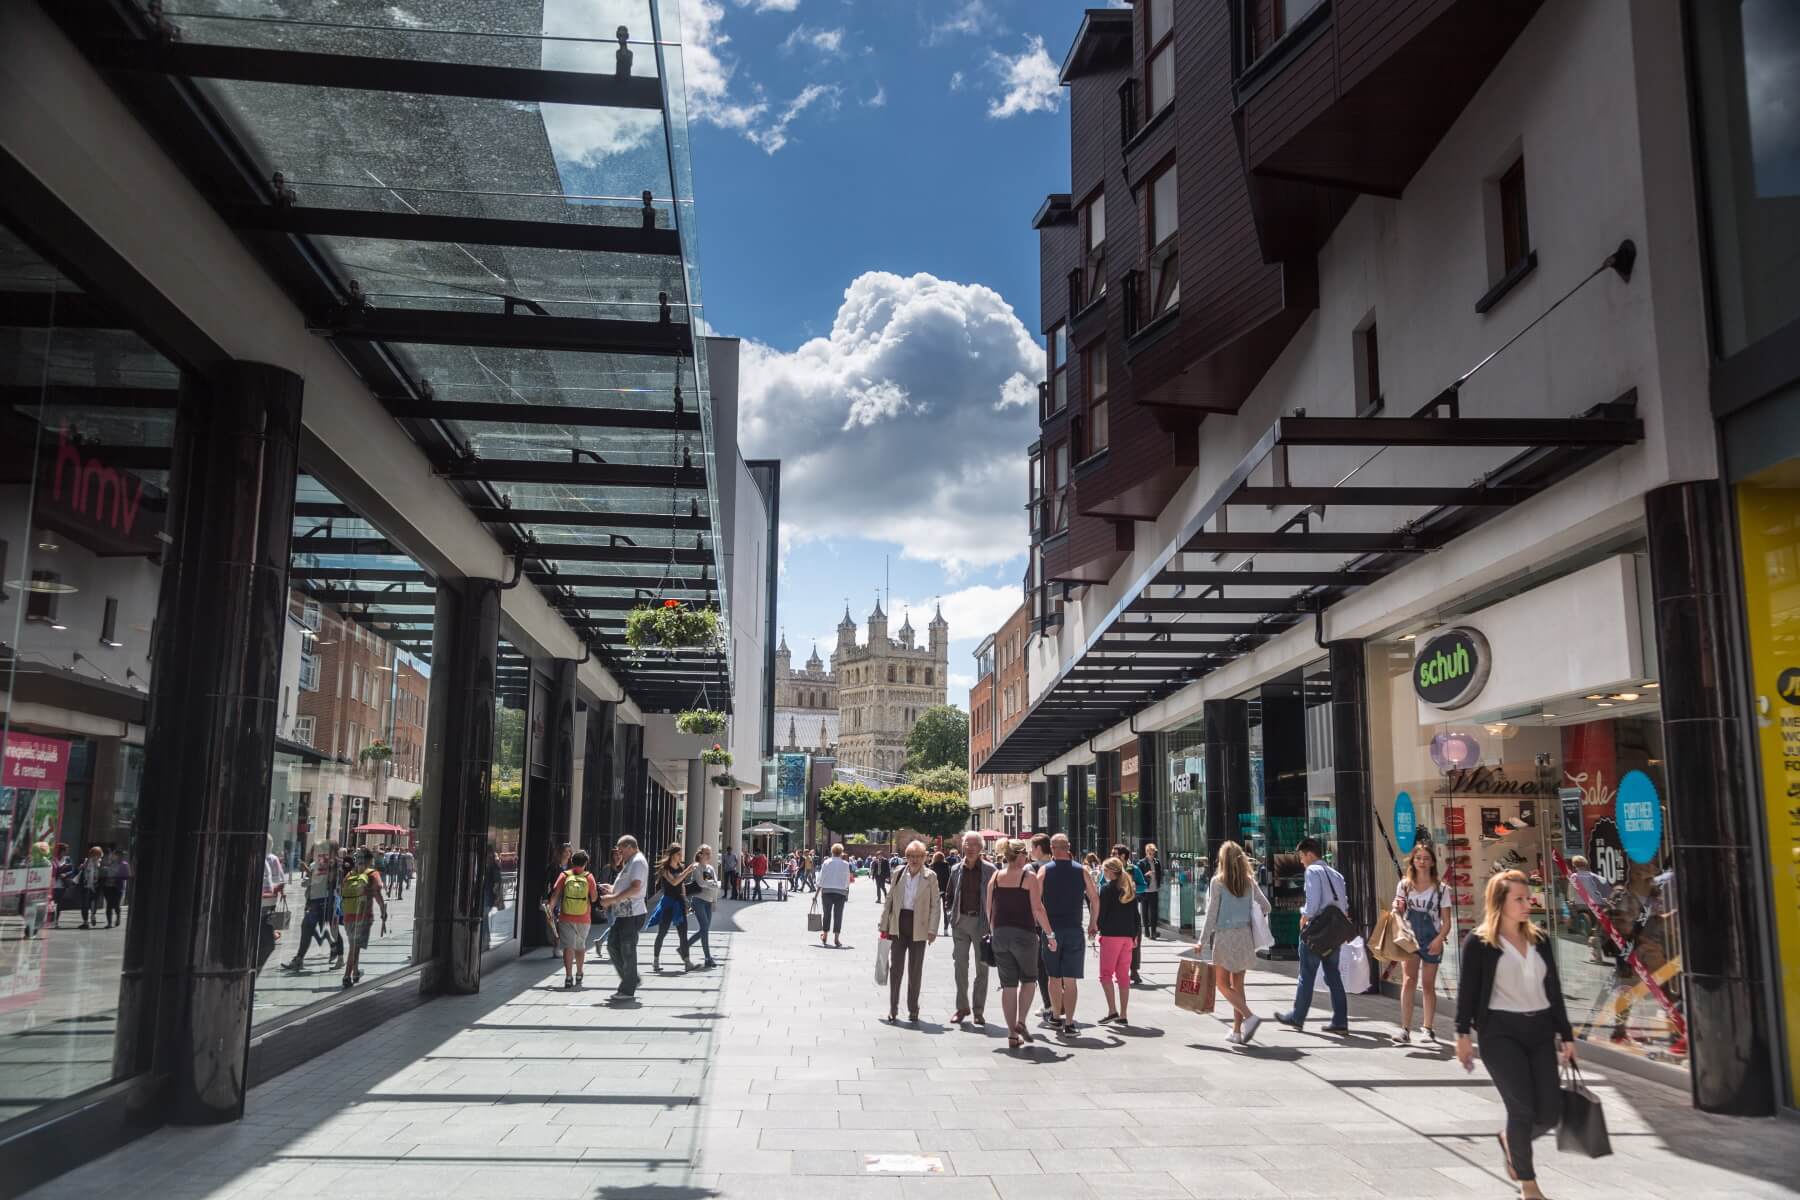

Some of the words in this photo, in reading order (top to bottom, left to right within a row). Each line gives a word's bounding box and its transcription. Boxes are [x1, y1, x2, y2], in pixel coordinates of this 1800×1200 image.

[54, 417, 143, 536] hmv
[1420, 642, 1470, 688] schuh
[1171, 773, 1191, 793] TIGER
[1564, 770, 1616, 805] Sale
[1624, 801, 1653, 819] FURTHER
[1596, 846, 1625, 884] 50%
